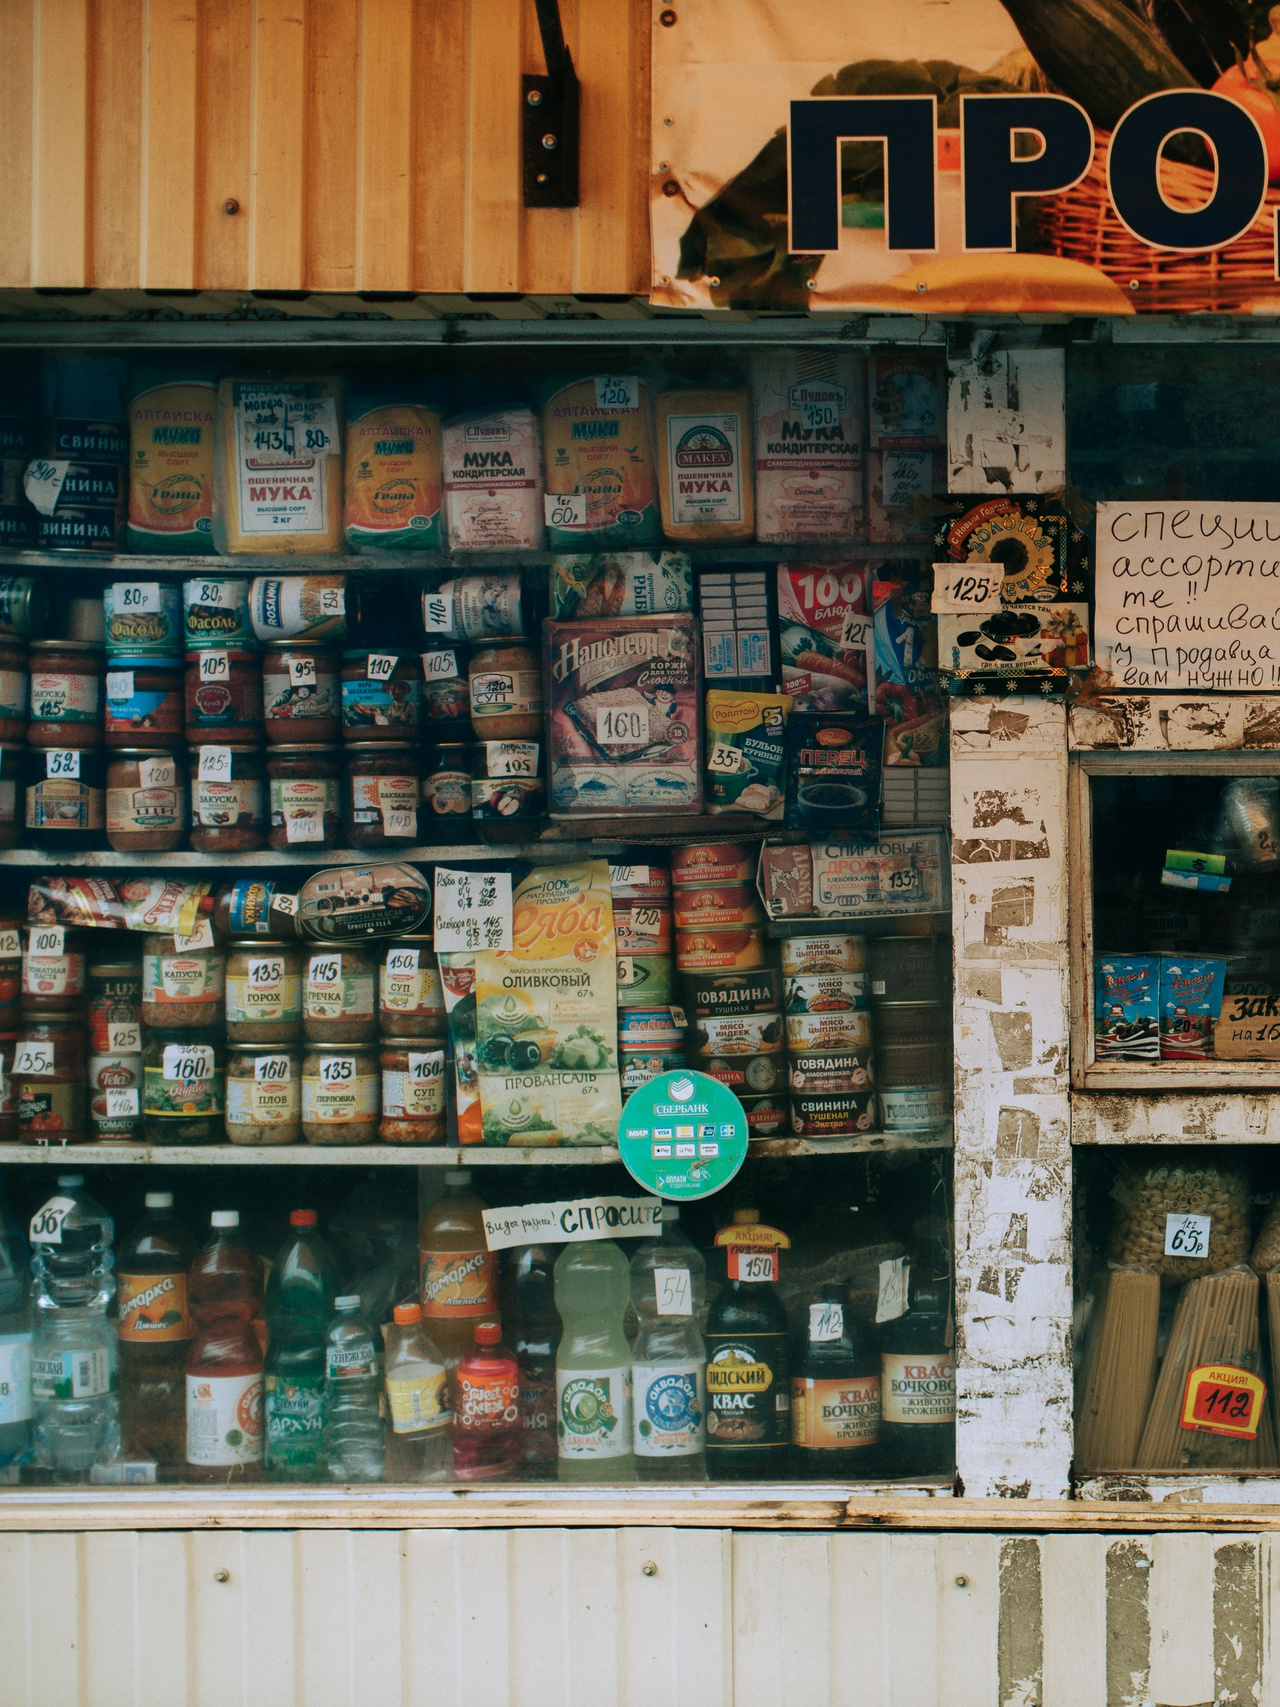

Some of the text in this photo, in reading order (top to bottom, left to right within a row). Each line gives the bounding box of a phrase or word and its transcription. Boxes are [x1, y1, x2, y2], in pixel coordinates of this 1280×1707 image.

[767, 442, 858, 456] КОНДИТЕРСКАЯ
[463, 451, 513, 468] МУКА
[452, 467, 525, 478] КОНДИТЕРСКАЯ
[250, 486, 312, 501] МУКА
[679, 481, 732, 494] МУКА
[970, 518, 1049, 553] ЗОЛОТАЯ
[797, 573, 863, 608] 100
[266, 580, 283, 628] ROSANNA
[553, 632, 661, 684] Наполеон
[476, 693, 507, 704] СУП
[745, 738, 784, 754] БУЛЬОН
[743, 747, 782, 762] КУРИНЫЙ
[800, 749, 867, 768] ПЕРЕЦ
[199, 795, 238, 804] ЗАКУСКА
[825, 842, 924, 859] СПИРТОВЫЕ
[541, 879, 569, 892] 100%
[527, 886, 579, 899] НАТУРАЛЬНЫЙ
[536, 897, 569, 905] ПРОДУКТ
[513, 893, 601, 948] Ряба
[795, 948, 844, 957] ЦЫПЛЕНКА
[805, 943, 831, 951] МЯСО
[164, 969, 203, 979] КАПУСТА
[312, 961, 338, 981] 145
[502, 972, 590, 988] ОЛИВКОВЫЙ
[817, 981, 844, 989] МЯСО
[104, 982, 139, 996] LUX
[390, 983, 411, 993] СУП
[247, 992, 281, 1002] ГОРОХ
[308, 992, 341, 1001] ГРЕЧКА
[698, 987, 771, 1004] ГОВЯДИНА
[715, 1005, 749, 1014] ТУШЕНАЯ
[719, 1023, 744, 1031] МЯСО
[807, 1025, 856, 1034] ЦЫПЛЕНКА
[818, 1019, 845, 1028] МЯСО
[112, 1029, 136, 1046] 125
[716, 1029, 750, 1037] ИНДЕЕК
[260, 1060, 287, 1079] 160
[797, 1057, 859, 1070] ГОВЯДИНА
[324, 1062, 352, 1080] 135
[505, 1073, 597, 1090] ПРОВАНСАЛЬ
[258, 1095, 288, 1105] ПЛОВ
[316, 1094, 356, 1103] ПЕРЛОВКА
[656, 1104, 709, 1114] СБЕРБАНК
[801, 1099, 858, 1112] СВИНИНА
[808, 1111, 849, 1120] ТУШЕНАЯ
[98, 1120, 134, 1129] TOMATO
[735, 1232, 773, 1242] АКЦИЯ!
[424, 1254, 486, 1302] Ярмарка
[663, 1275, 687, 1307] 54
[707, 1369, 766, 1384] ЛИДСКИЙ
[903, 1365, 952, 1380] КВАС
[1208, 1371, 1249, 1385] АКЦИЯ!
[713, 1393, 755, 1410] КВАС
[907, 1397, 951, 1407] ЖИВОГО
[1205, 1389, 1250, 1418] 112
